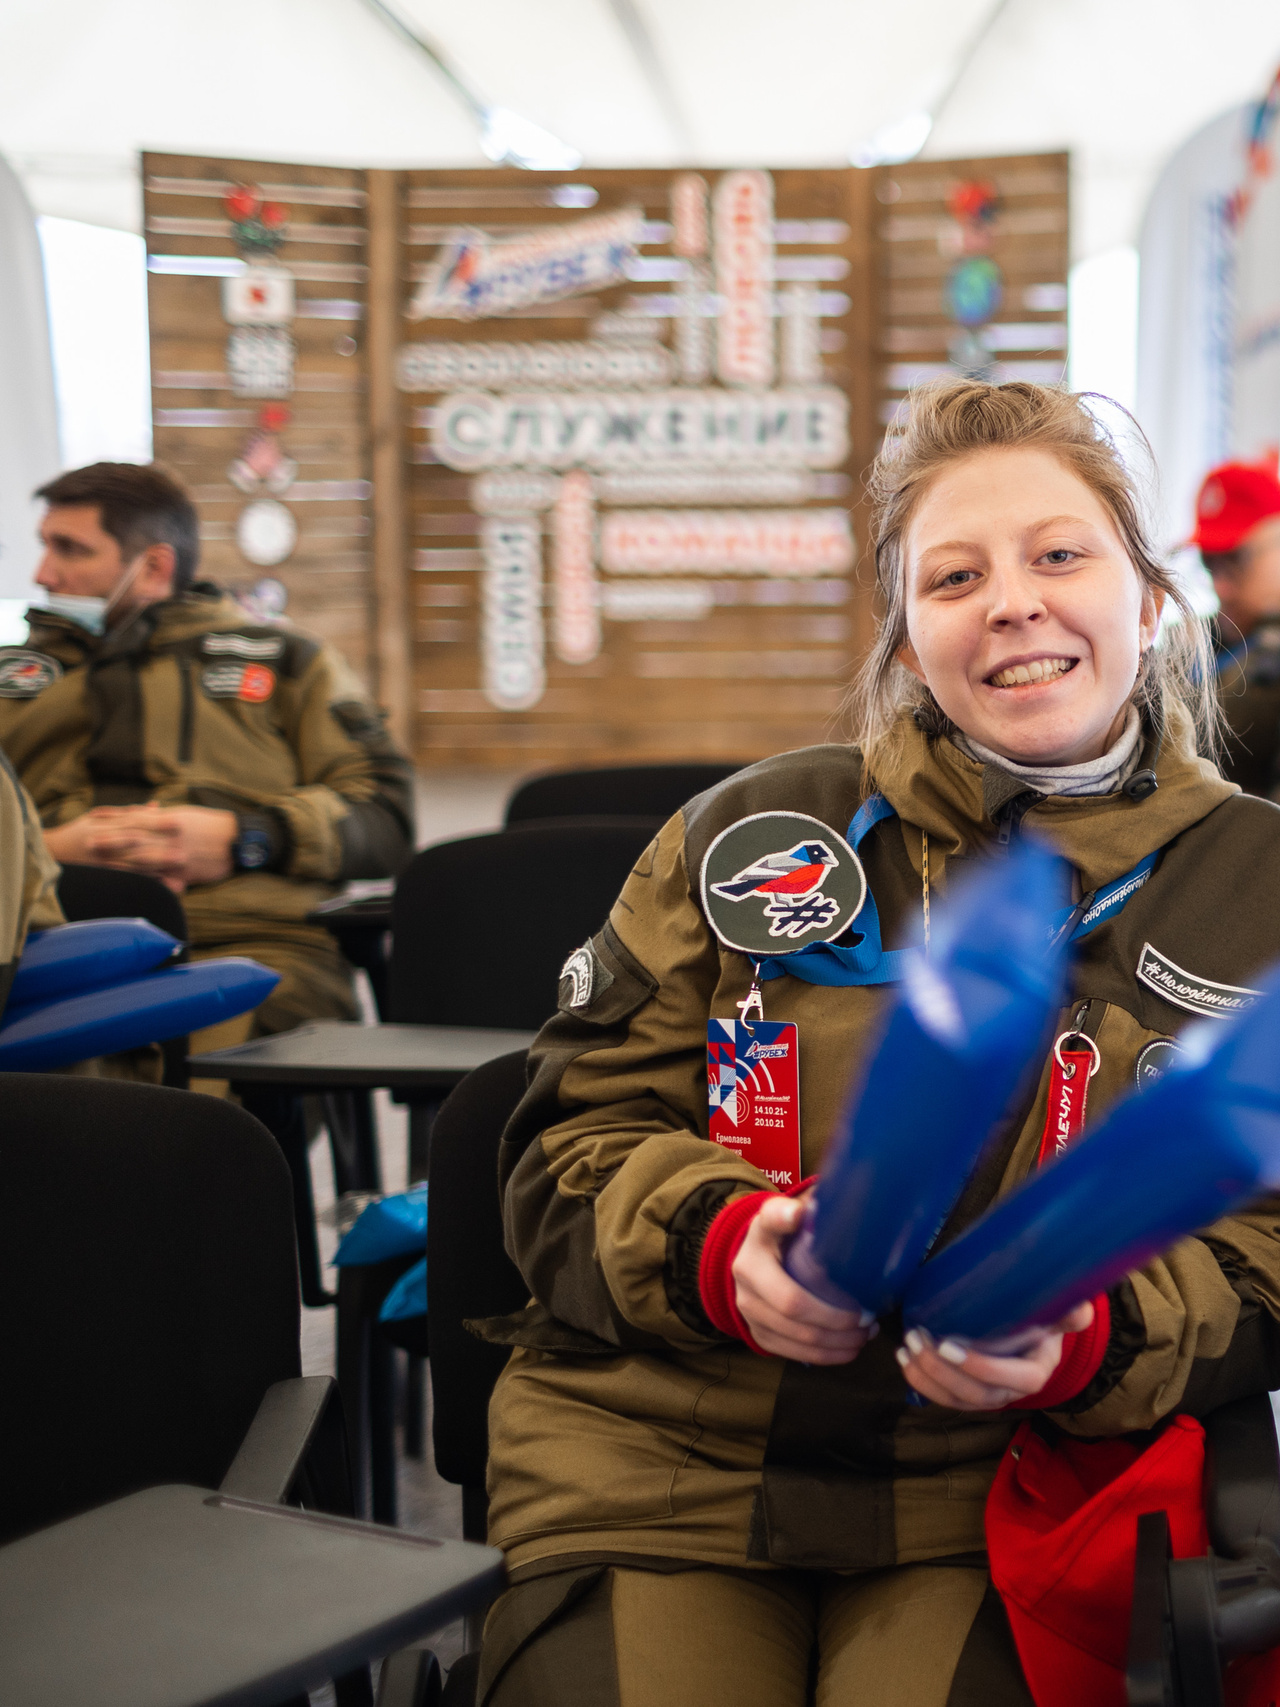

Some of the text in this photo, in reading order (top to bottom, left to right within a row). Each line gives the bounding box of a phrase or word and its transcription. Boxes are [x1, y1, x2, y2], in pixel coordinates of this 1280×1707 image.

[442, 398, 840, 460] СЛУЖЕНИЕ
[754, 1105, 788, 1116] 14.10.21-
[754, 1117, 785, 1128] 20.10.21
[716, 1132, 752, 1145] Ермолаева
